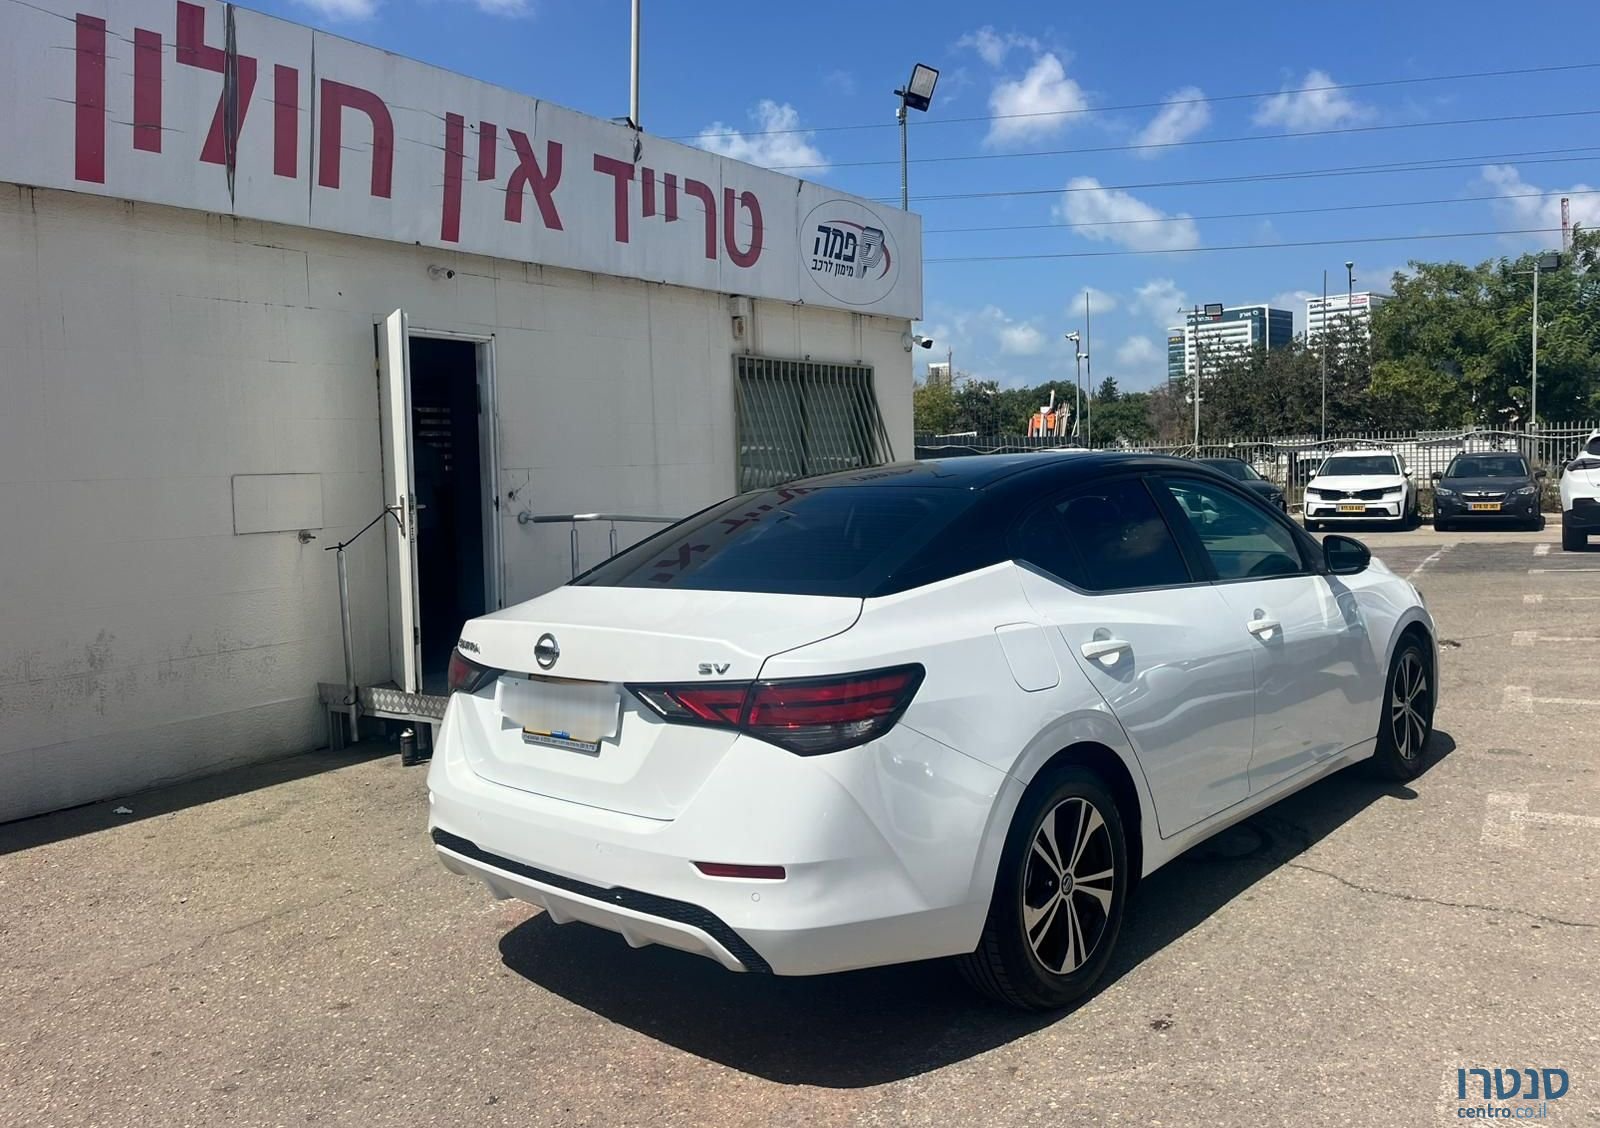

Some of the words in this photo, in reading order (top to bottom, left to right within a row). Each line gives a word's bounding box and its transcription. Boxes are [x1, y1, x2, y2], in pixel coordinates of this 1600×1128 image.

[74, 0, 394, 200] חולון
[440, 111, 564, 243] אין
[593, 151, 763, 268] טרייד
[811, 258, 834, 273] לרכב
[834, 263, 854, 277] מימון
[698, 663, 731, 675] SV
